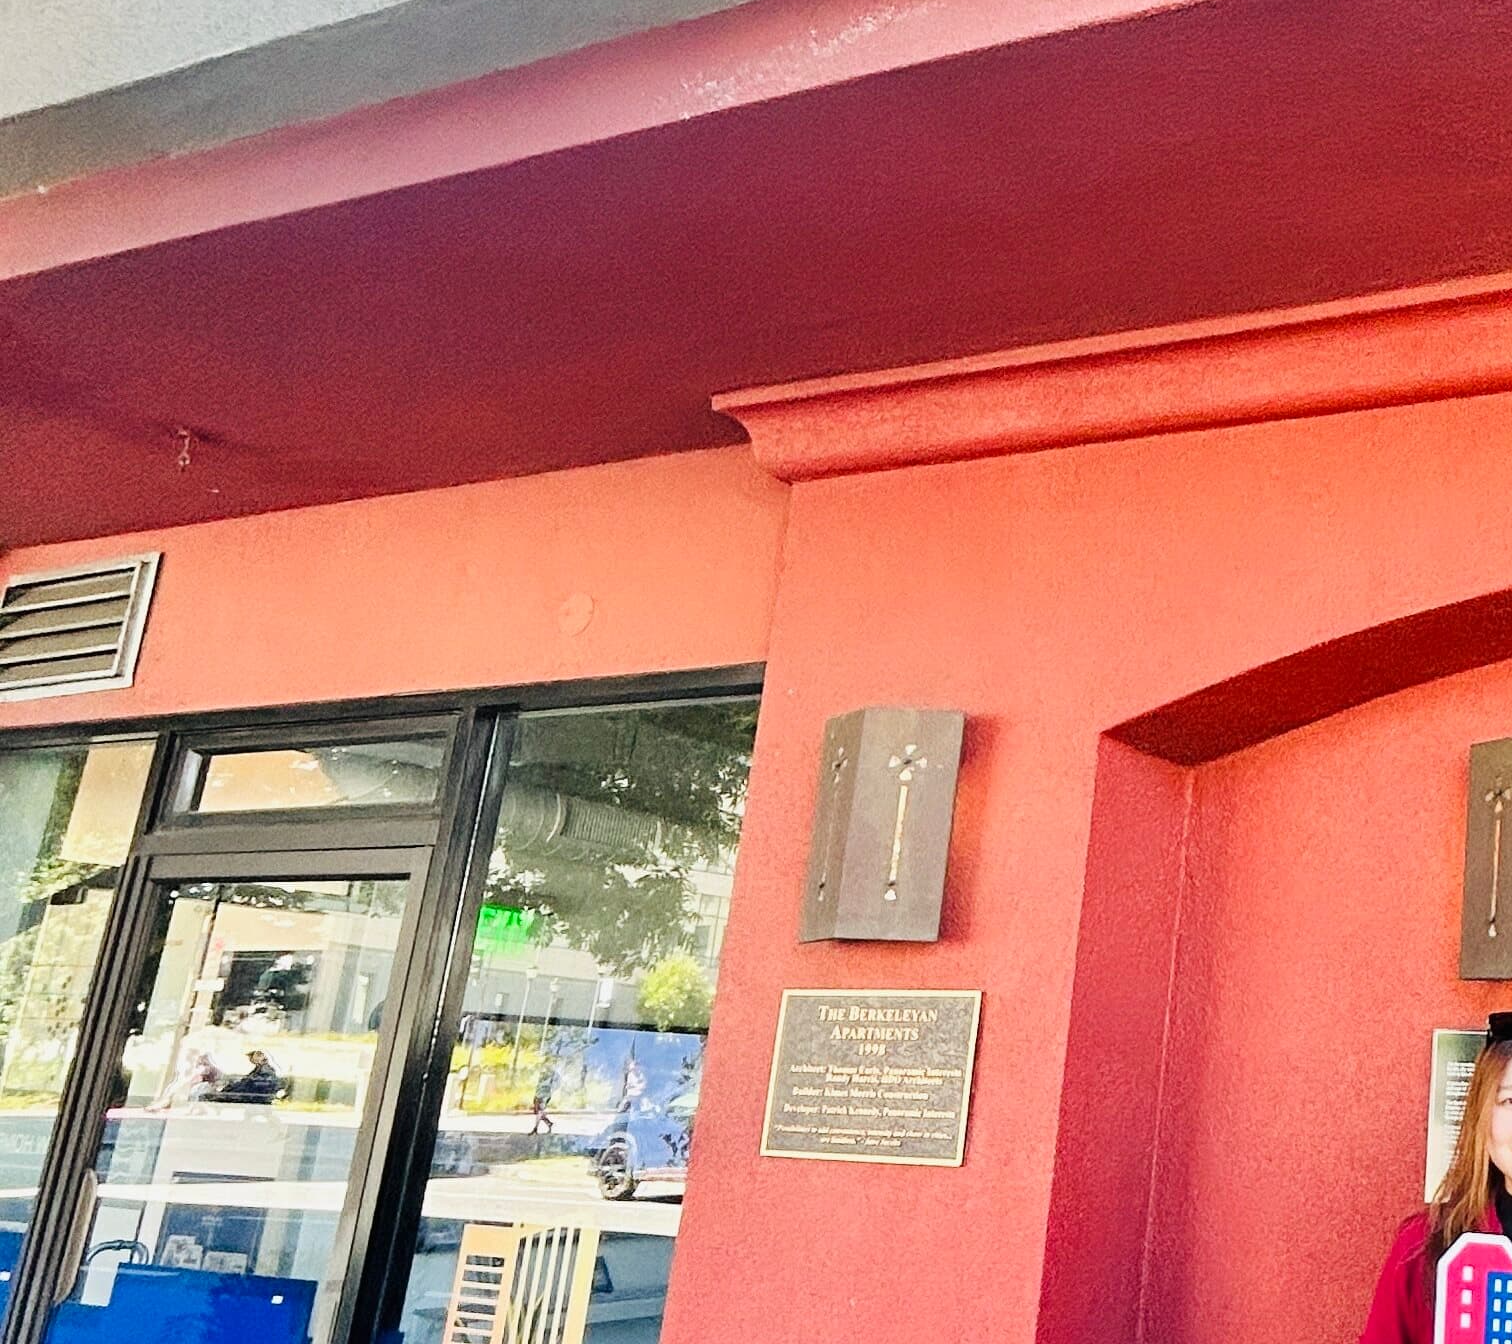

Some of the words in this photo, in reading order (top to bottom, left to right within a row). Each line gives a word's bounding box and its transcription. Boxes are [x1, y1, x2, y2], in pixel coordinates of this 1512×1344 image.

[817, 1005, 847, 1022] THE
[848, 1005, 939, 1023] BERKELEYAN
[830, 1024, 920, 1041] APARTMENTS
